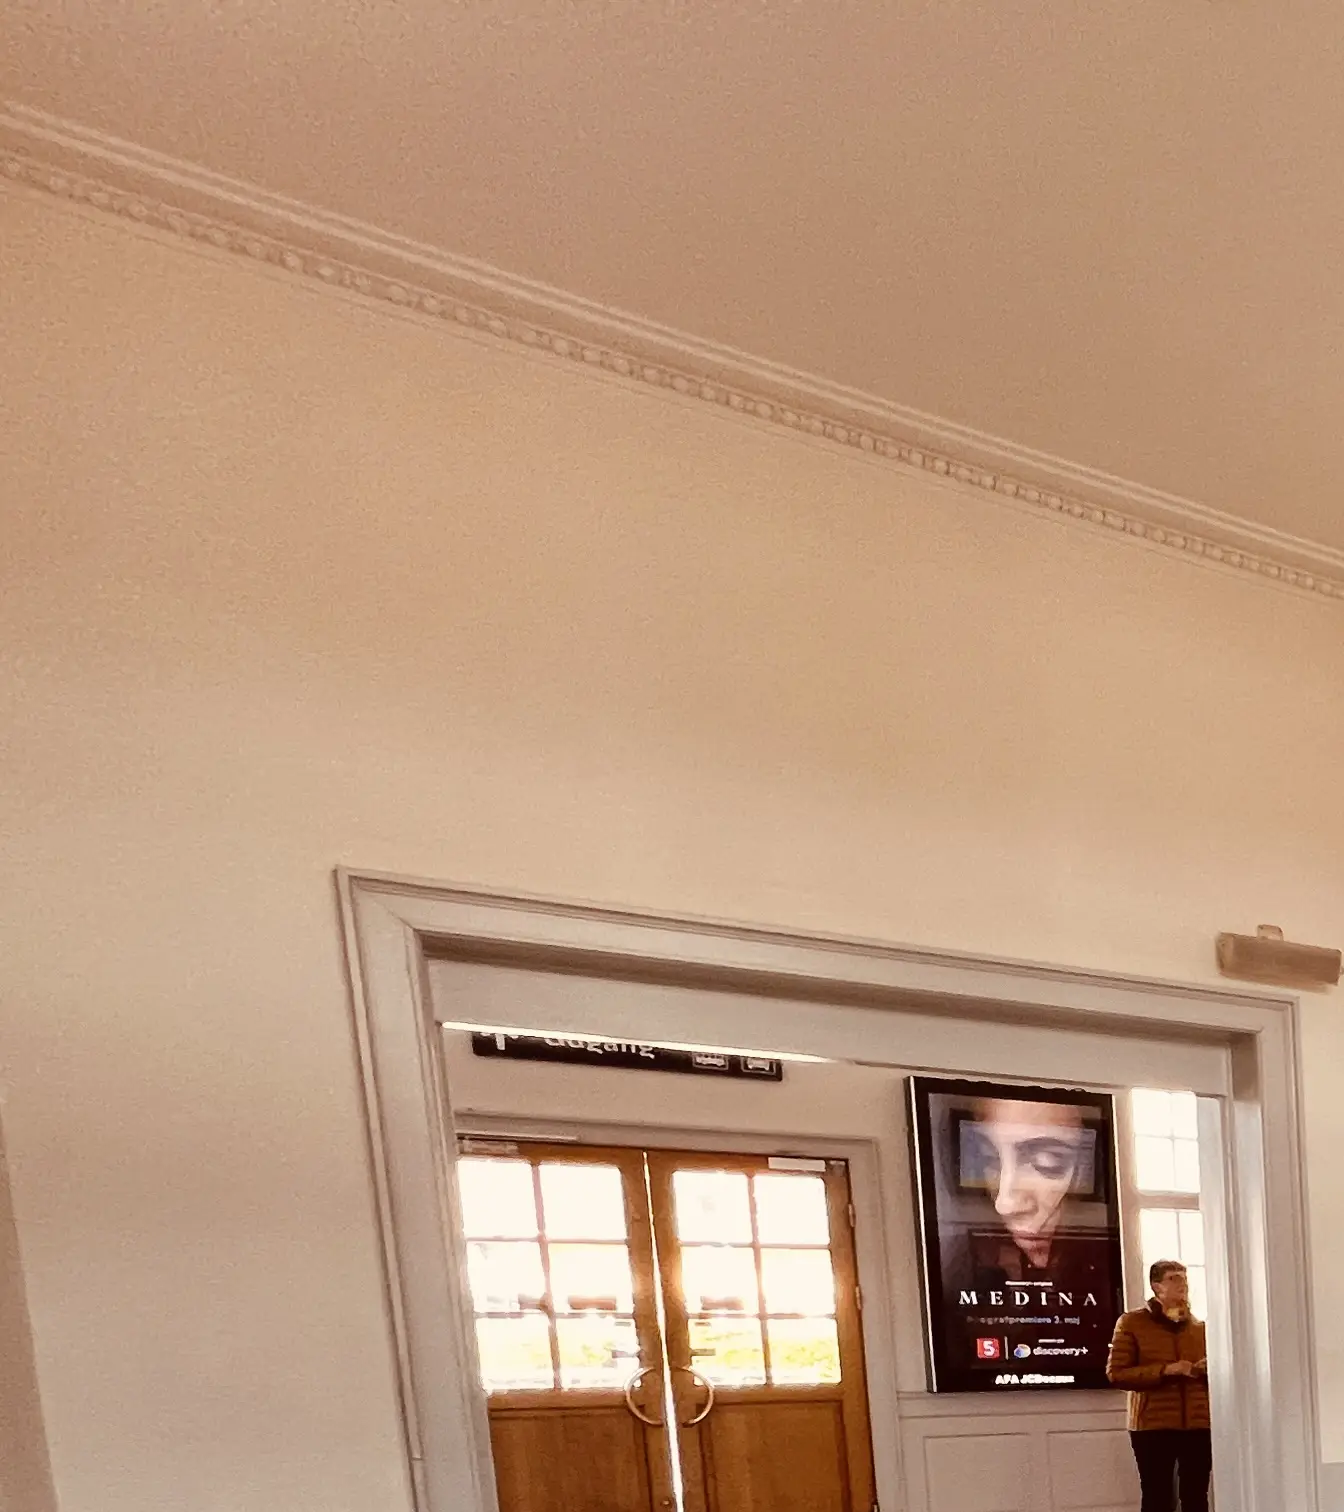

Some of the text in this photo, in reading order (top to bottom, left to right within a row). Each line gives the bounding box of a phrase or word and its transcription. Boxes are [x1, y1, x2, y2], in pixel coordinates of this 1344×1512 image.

[958, 1290, 1098, 1306] MEDINA
[983, 1340, 996, 1357] 5
[1032, 1346, 1089, 1357] discovery+
